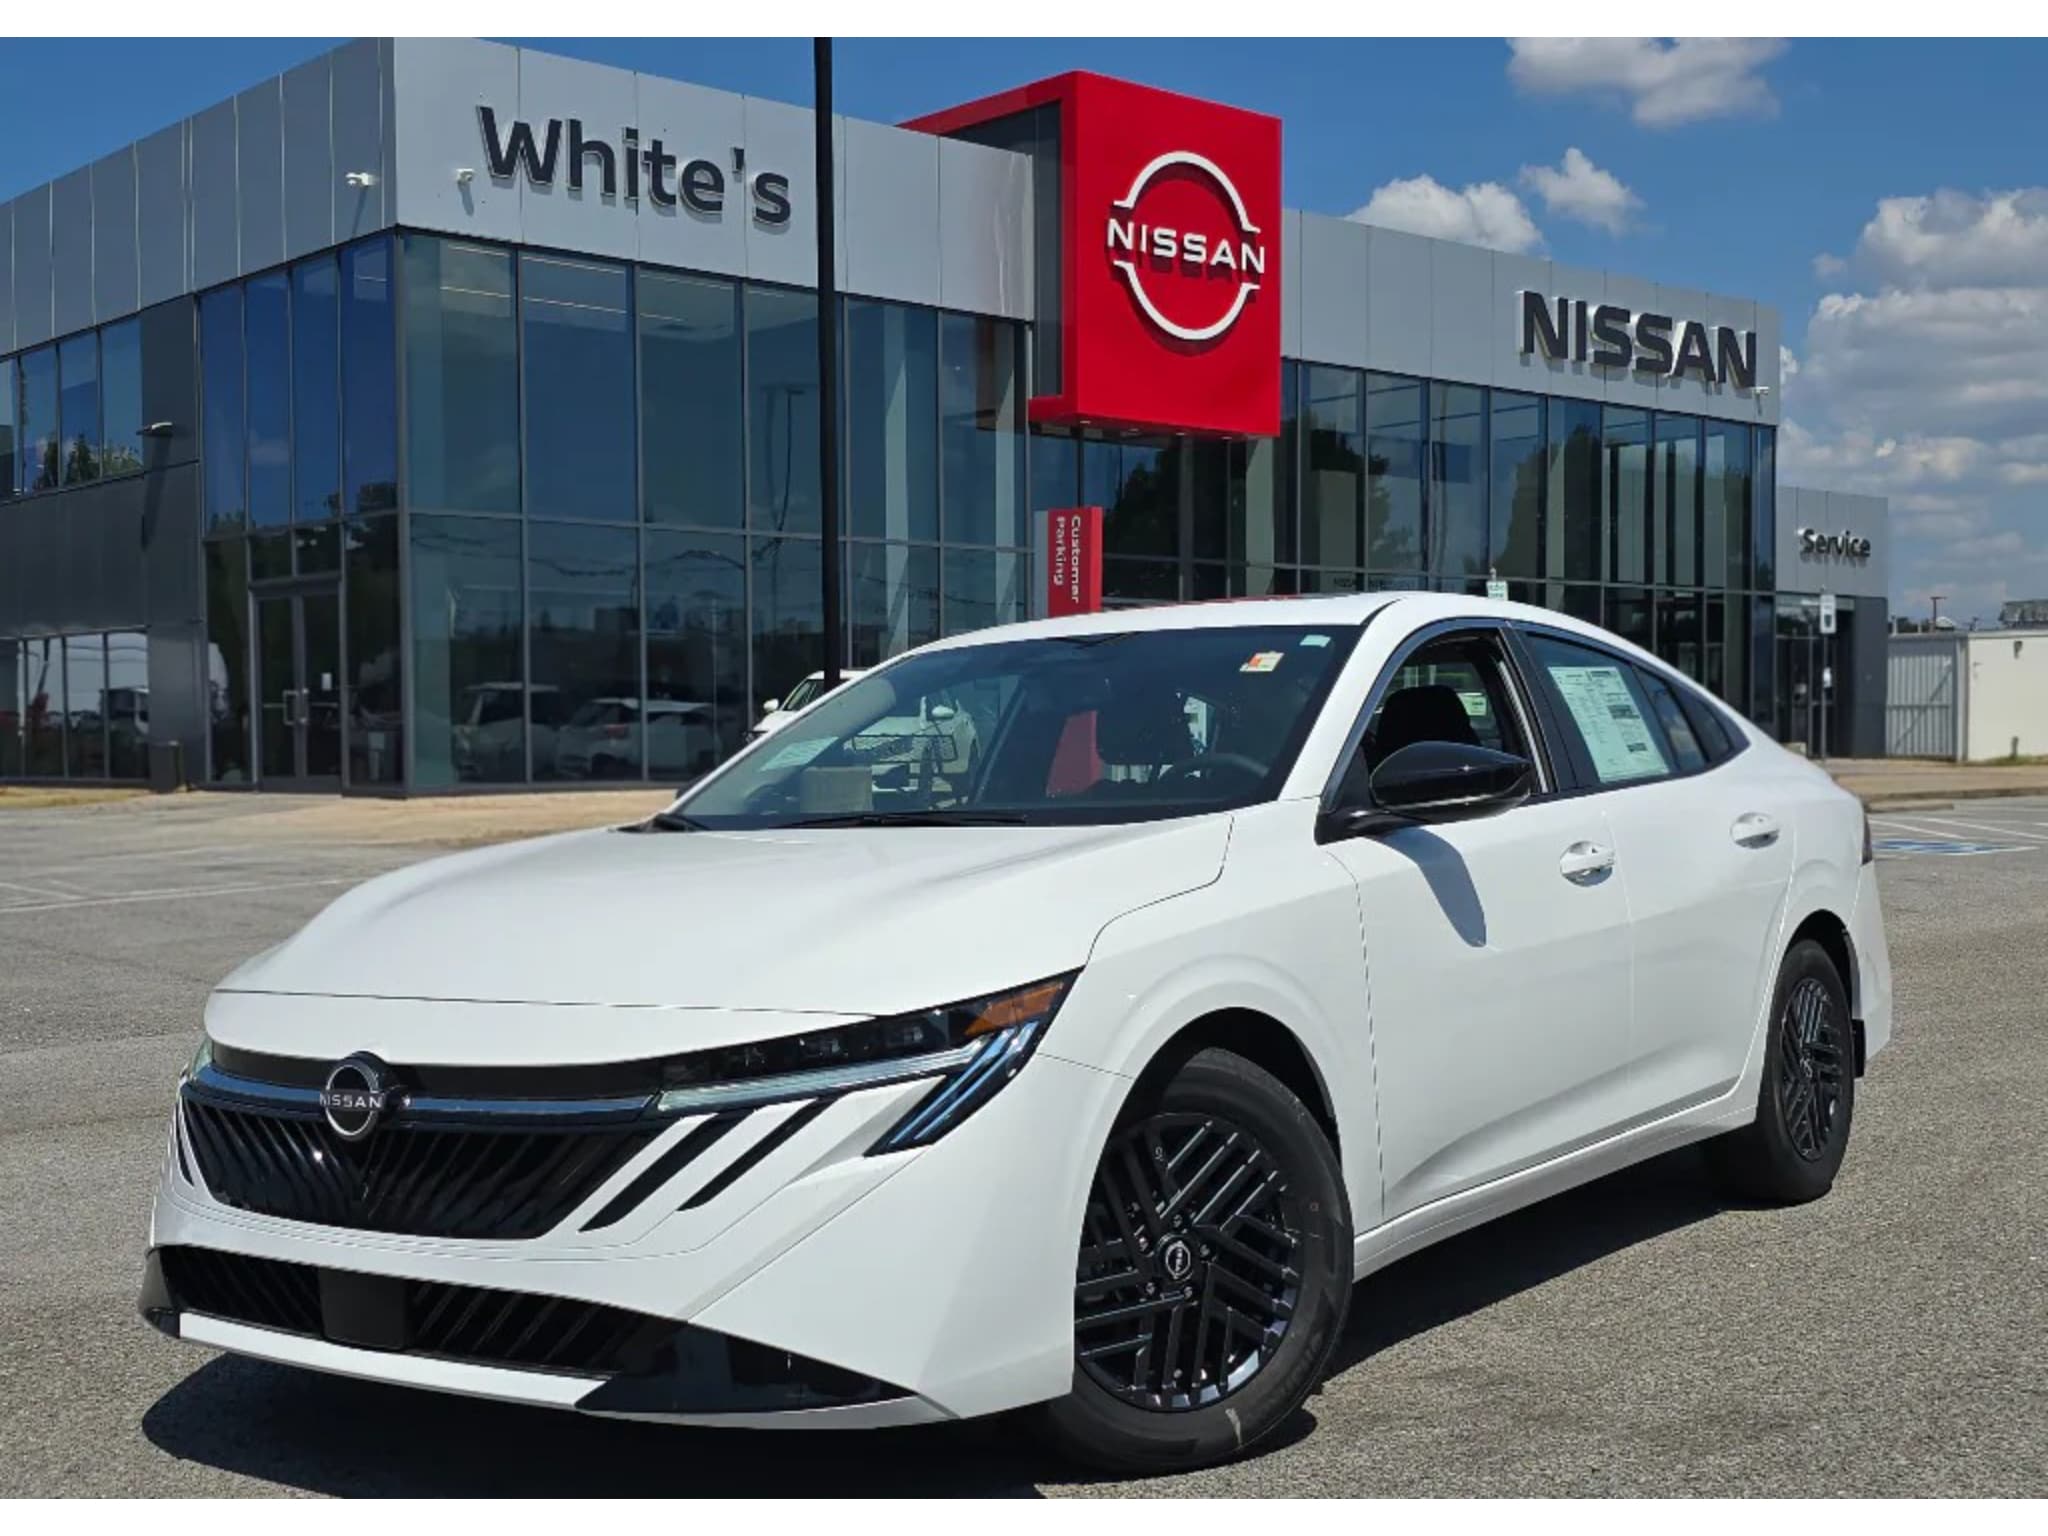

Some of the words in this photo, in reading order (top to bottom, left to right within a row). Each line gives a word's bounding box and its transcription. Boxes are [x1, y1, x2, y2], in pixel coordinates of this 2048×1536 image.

[477, 105, 792, 223] White's
[1107, 218, 1265, 274] NISSAN
[1519, 290, 1757, 388] NISSAN
[1053, 516, 1066, 586] Parking
[1070, 514, 1082, 604] Customer
[1800, 529, 1871, 558] Service
[320, 1093, 383, 1109] NISSAN
